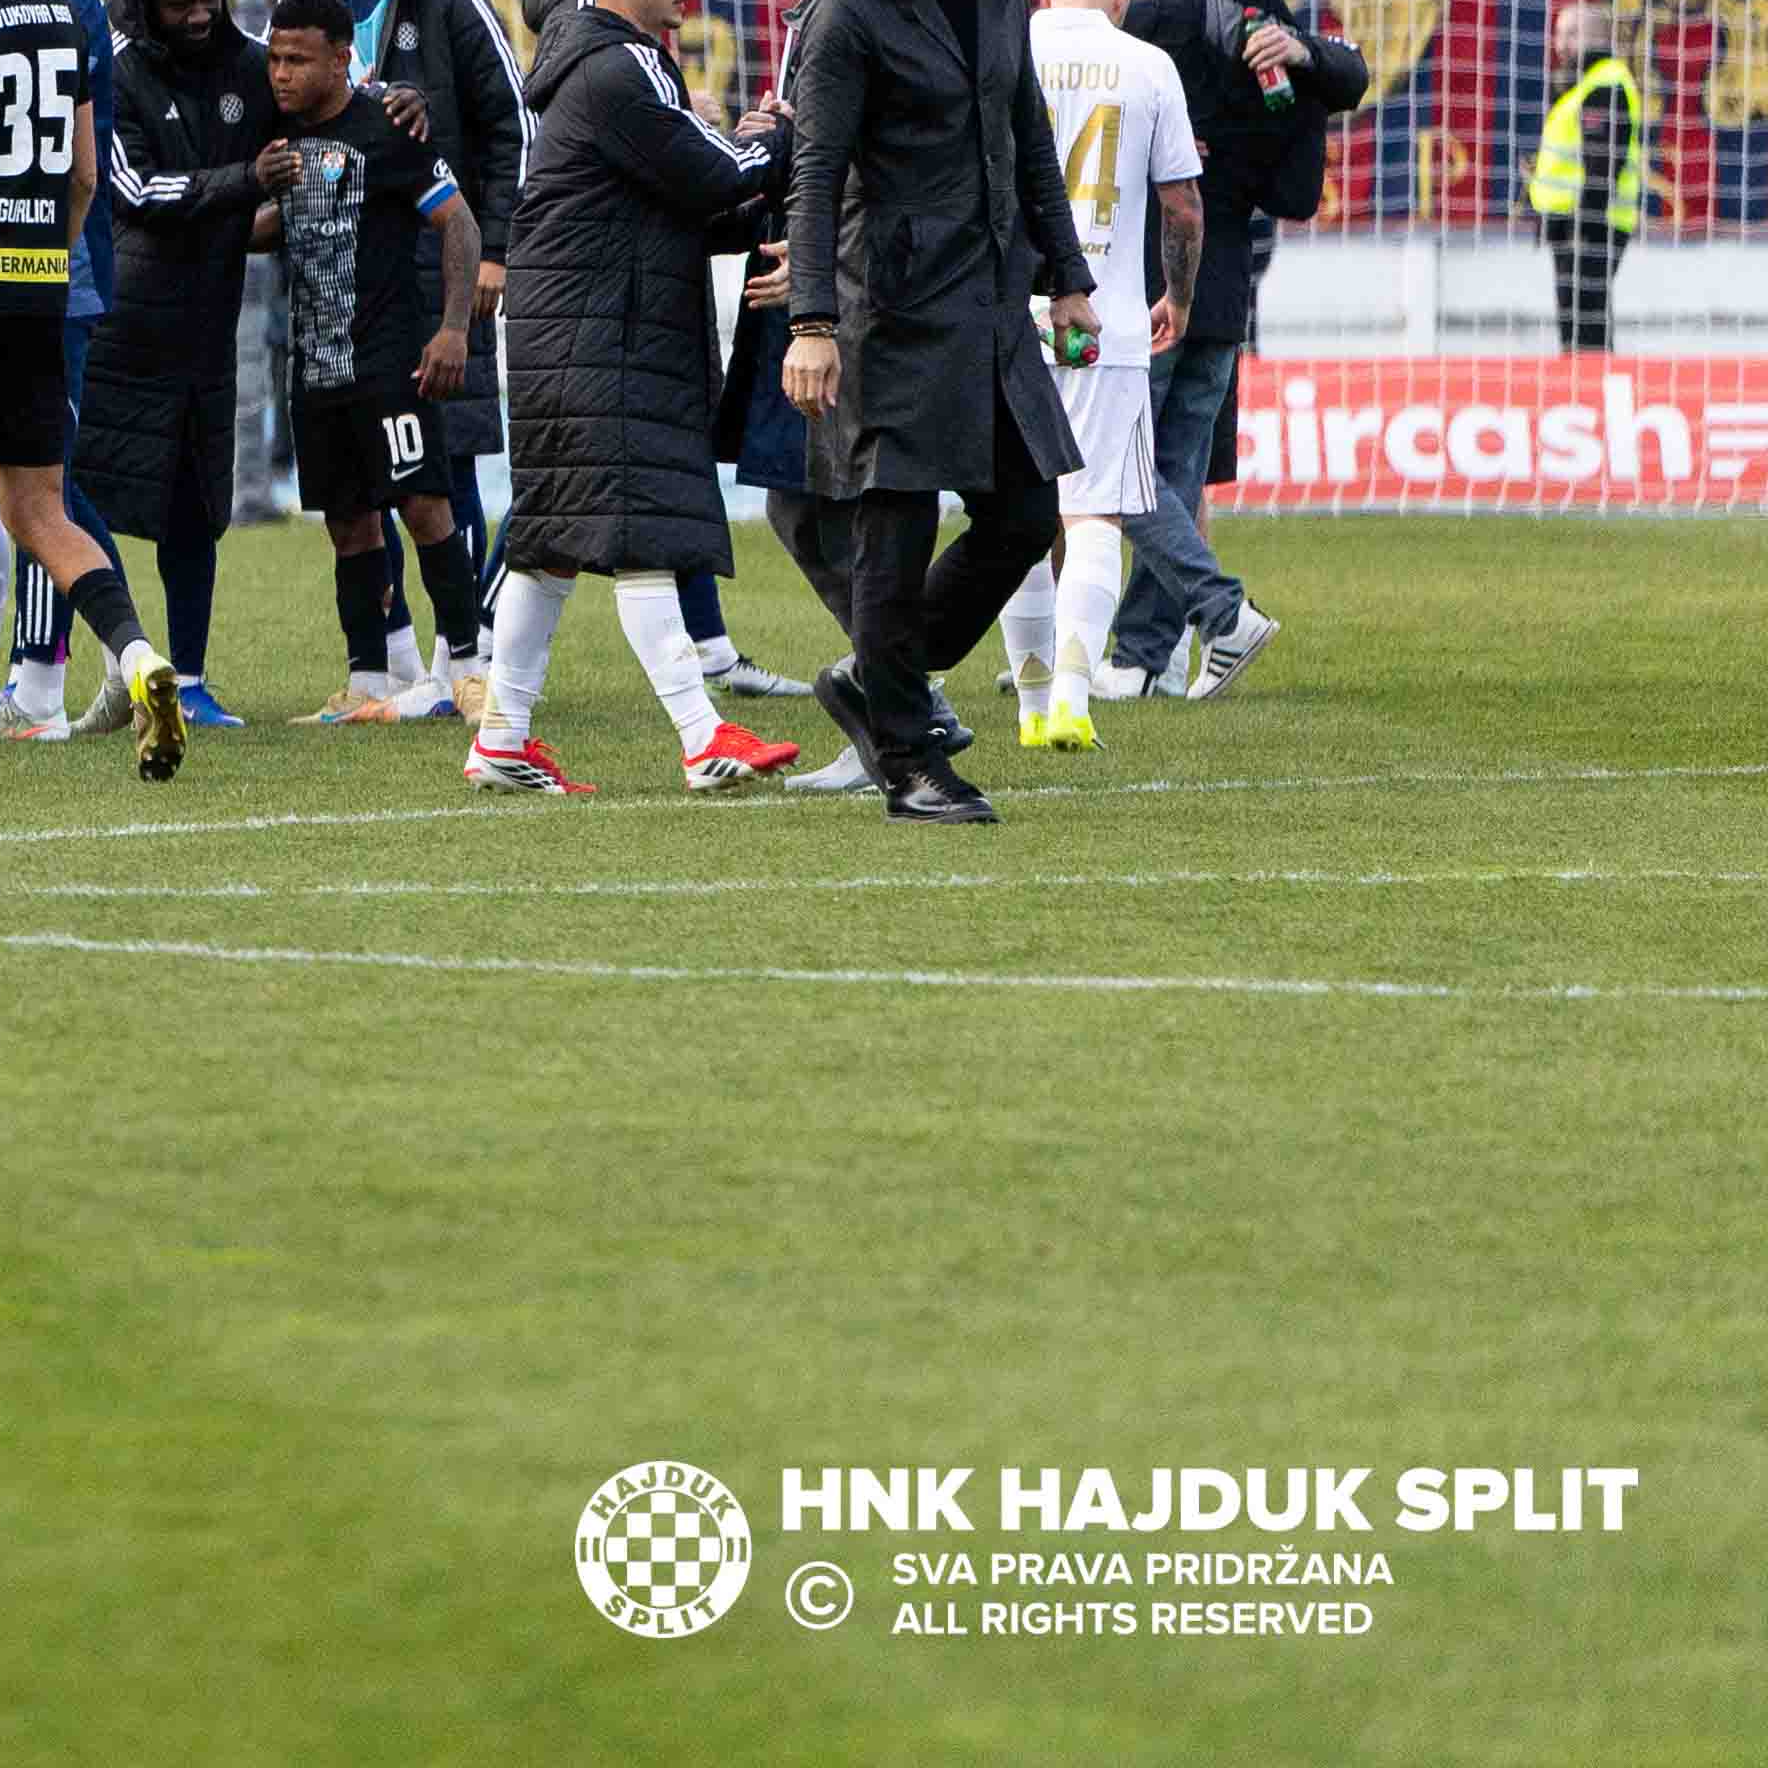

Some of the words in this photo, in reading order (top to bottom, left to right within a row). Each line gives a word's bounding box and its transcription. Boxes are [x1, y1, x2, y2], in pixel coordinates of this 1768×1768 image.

[1047, 100, 1122, 227] 4
[382, 413, 424, 465] 10
[1236, 374, 1692, 483] aircash
